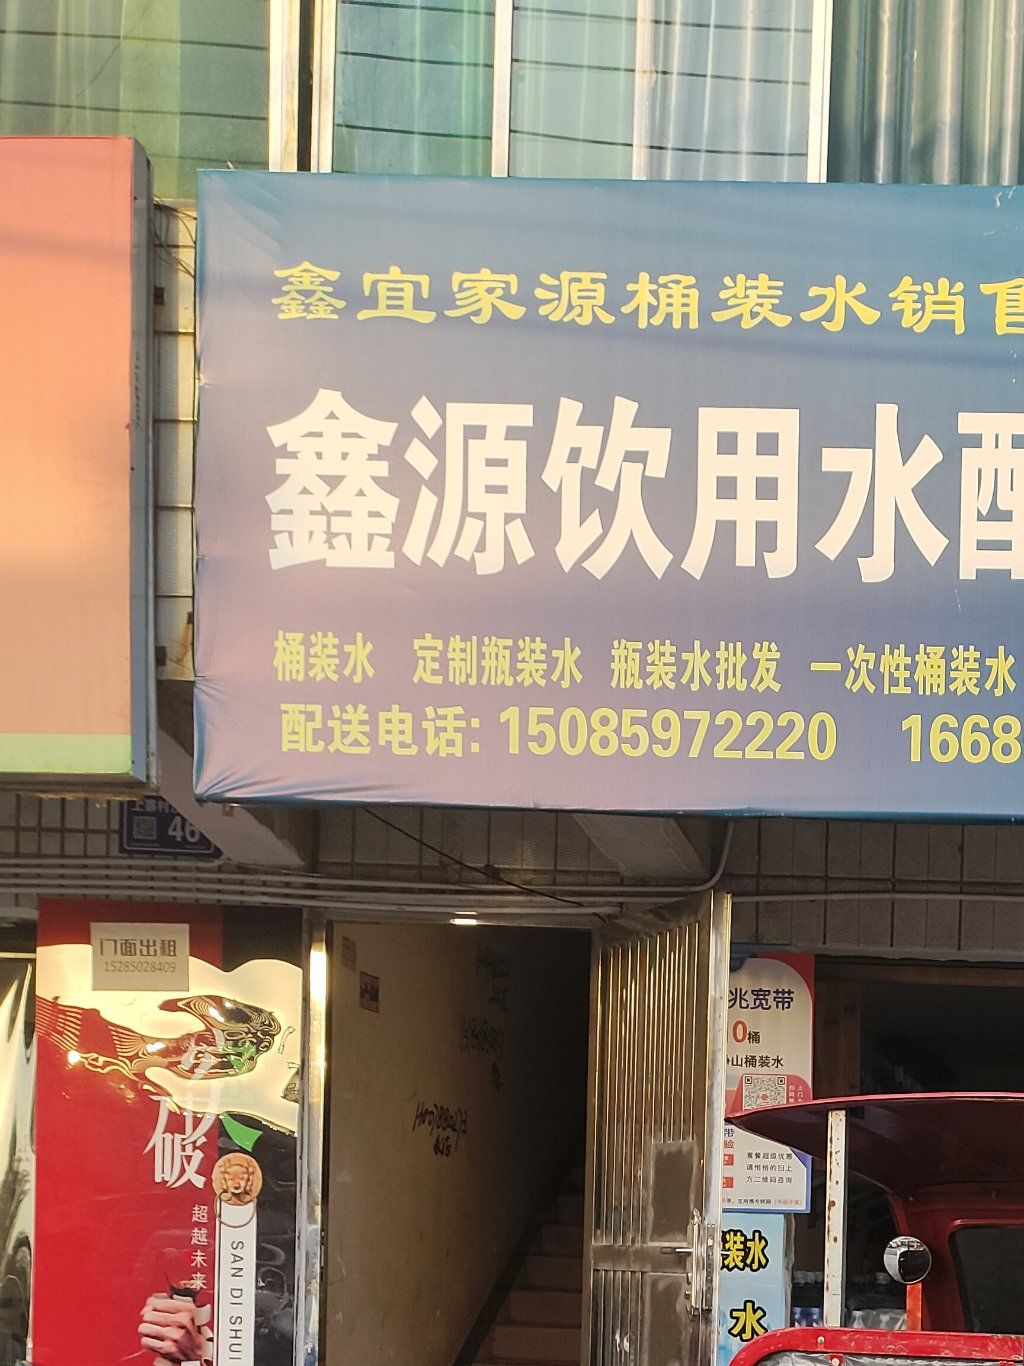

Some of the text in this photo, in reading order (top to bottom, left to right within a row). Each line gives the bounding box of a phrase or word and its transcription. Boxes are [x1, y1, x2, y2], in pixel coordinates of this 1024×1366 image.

[273, 630, 376, 684] 桶装水
[412, 633, 583, 689] 定制瓶装水
[610, 637, 782, 693] 瓶装水批发
[810, 643, 1018, 698] 一次性桶装水
[499, 706, 838, 761] 15085972220
[100, 938, 177, 958] 门面出租
[104, 960, 177, 973] 15285028409
[726, 1054, 784, 1068] 山桶装水
[190, 1204, 209, 1291] 超越未来
[720, 1229, 770, 1272] 装水
[228, 1239, 245, 1361] SAN DI SHUI
